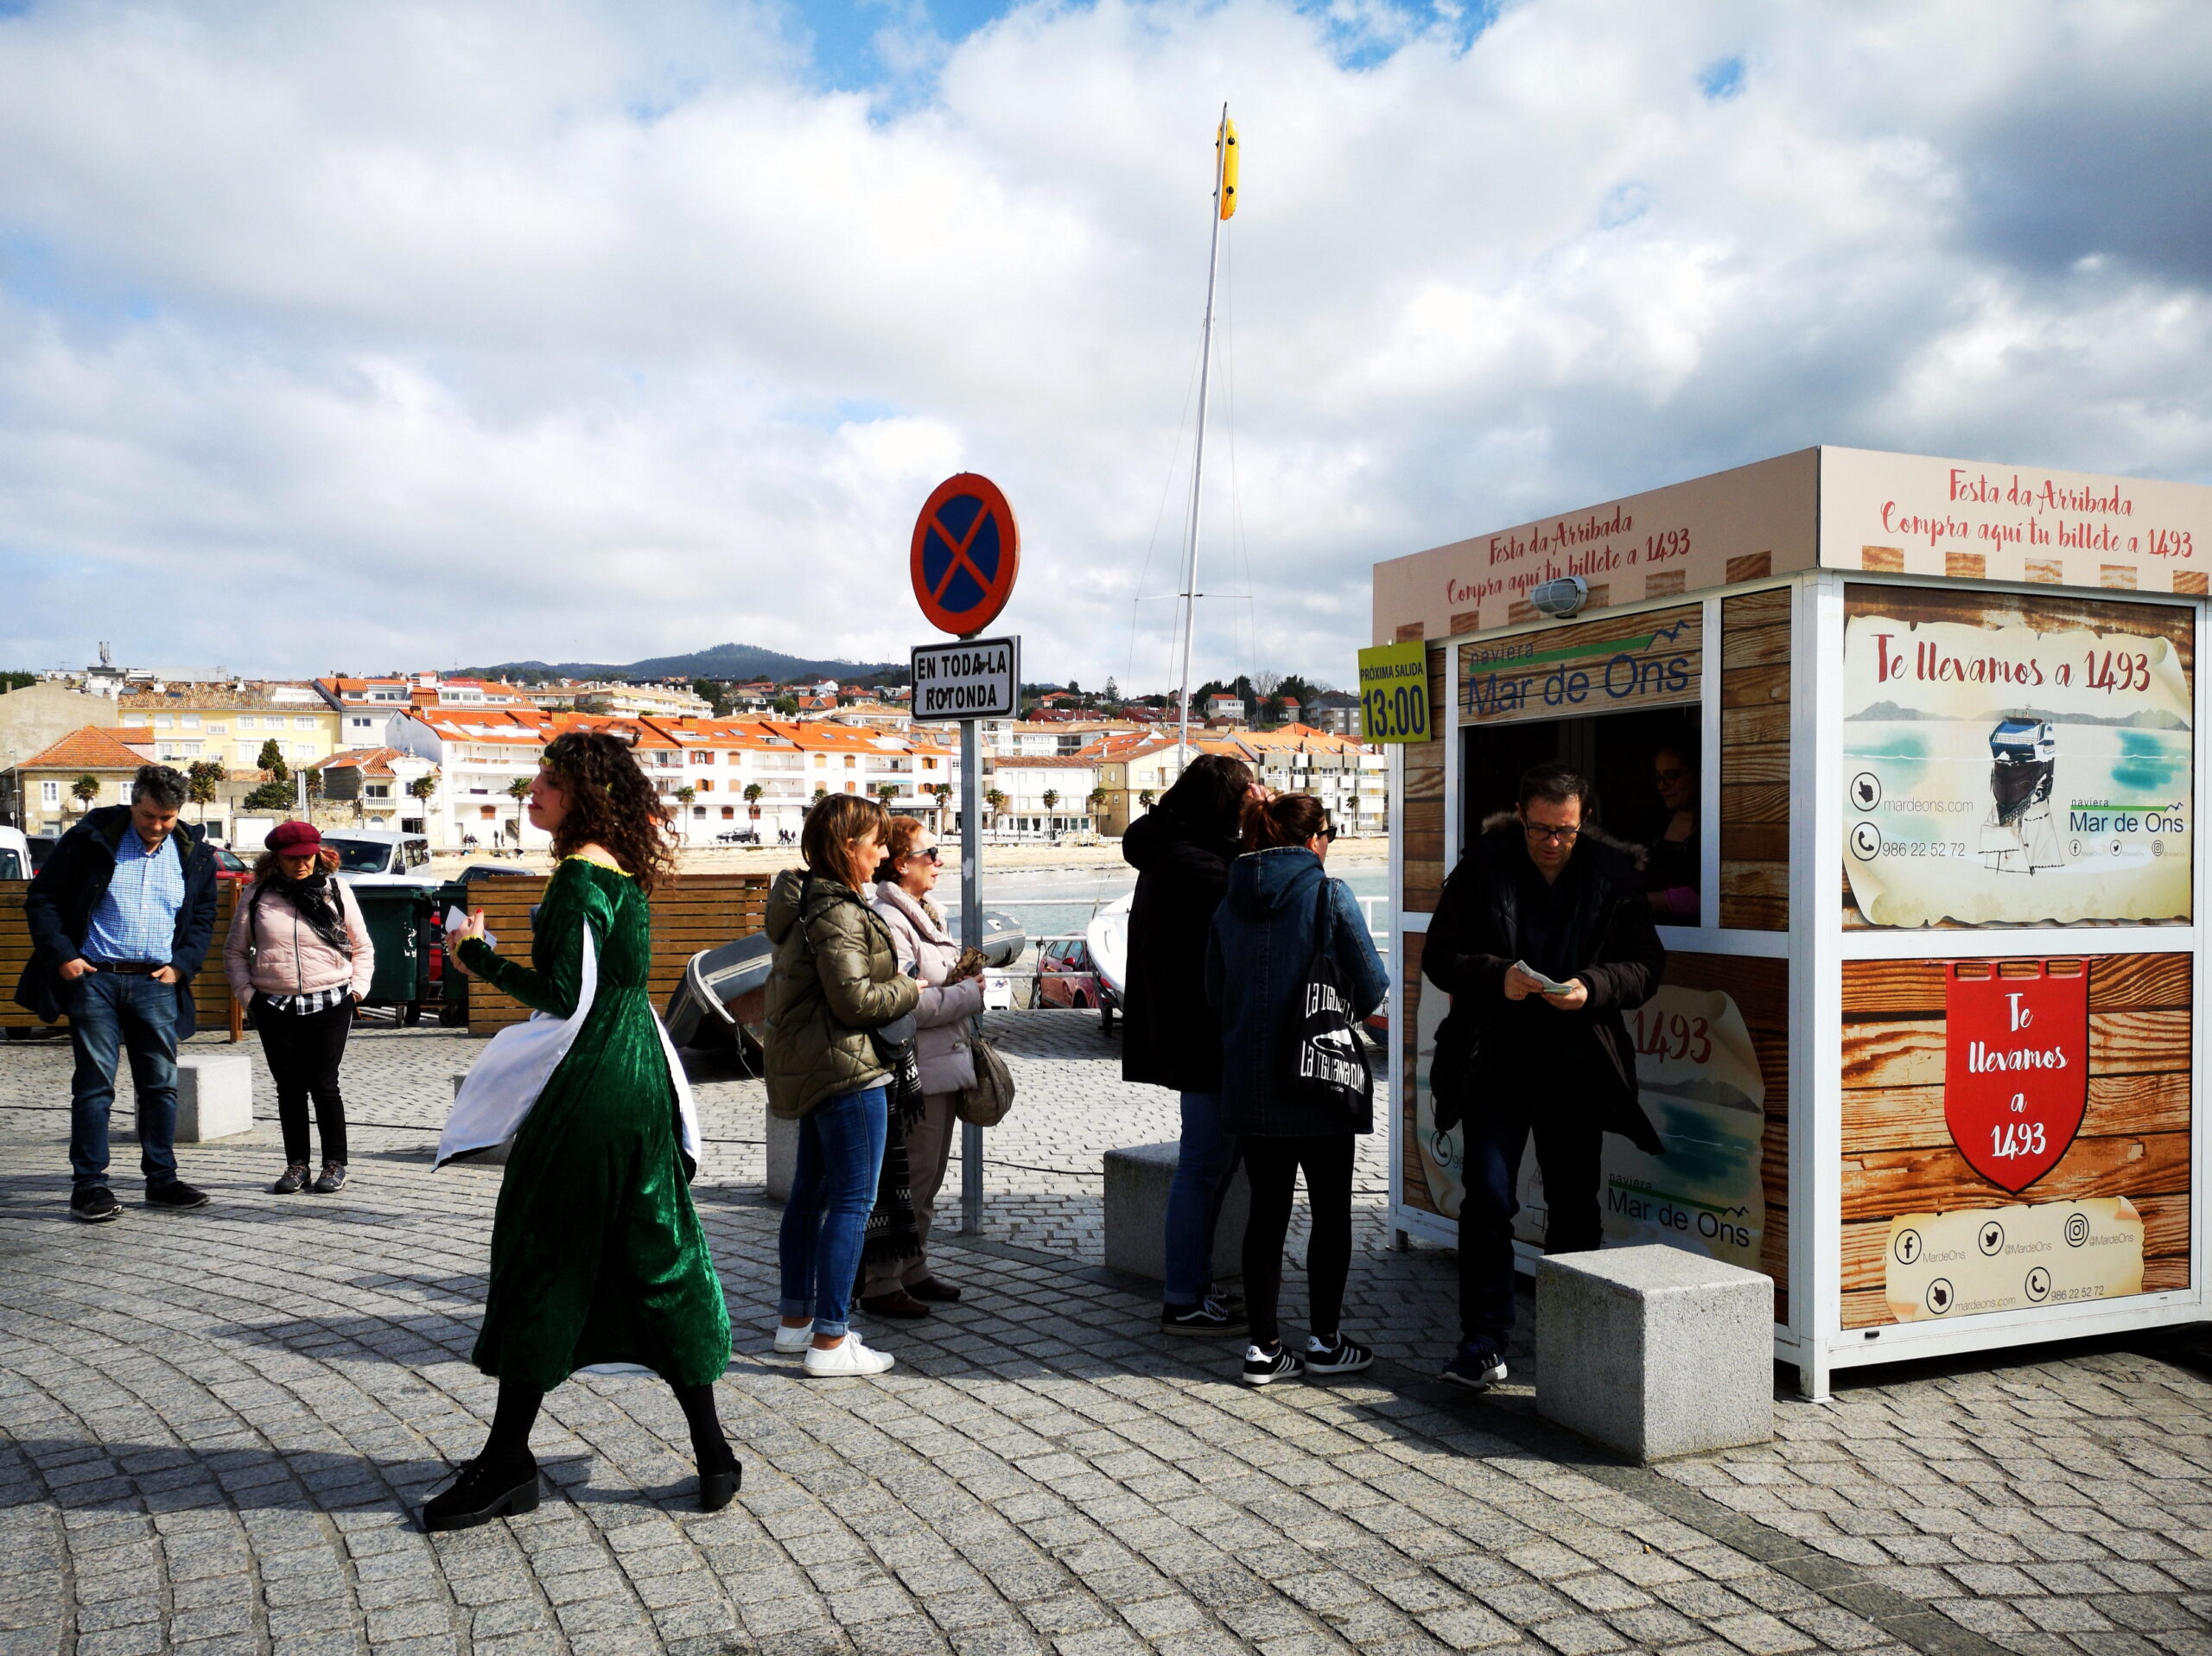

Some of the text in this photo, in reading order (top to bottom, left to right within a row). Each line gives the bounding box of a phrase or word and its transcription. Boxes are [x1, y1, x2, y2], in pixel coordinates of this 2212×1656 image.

[1950, 468, 2134, 517] Festa da Arribada
[1490, 505, 1632, 566] Festa da Arribada
[1880, 501, 2193, 559] Compra aquí tu billete a 1493
[1446, 528, 1691, 606] Compra aquí tu billete a 1493
[918, 650, 1007, 680] EN TODA LA
[1470, 643, 1535, 667] naviera
[1869, 633, 2152, 695] Te llevamos a 1493
[1360, 662, 1424, 682] PRÓXIMA SALIDA
[1467, 654, 1690, 715] Mar de Ons
[926, 684, 997, 710] ROTONDA
[1363, 685, 1426, 738] 13:00
[1884, 797, 1974, 813] mardeons.com
[2071, 797, 2109, 808] naviera
[2069, 812, 2184, 833] Mar de Ons
[1882, 841, 1966, 857] 986 22 52 72
[2005, 993, 2034, 1032] Te
[1632, 1011, 1712, 1064] 1493
[1968, 1041, 2069, 1074] llevamos
[2011, 1093, 2028, 1113] a
[1990, 1122, 2046, 1160] 1493
[1609, 1173, 1652, 1192] naviera
[1608, 1188, 1750, 1247] Mar de Ons
[2005, 1240, 2052, 1255] @MardeOns
[2088, 1233, 2134, 1247] @MardeOns
[1923, 1249, 1966, 1263] MardeOns
[1955, 1295, 2016, 1312] mardeons.com
[2050, 1285, 2105, 1301] 986 22 52 72
